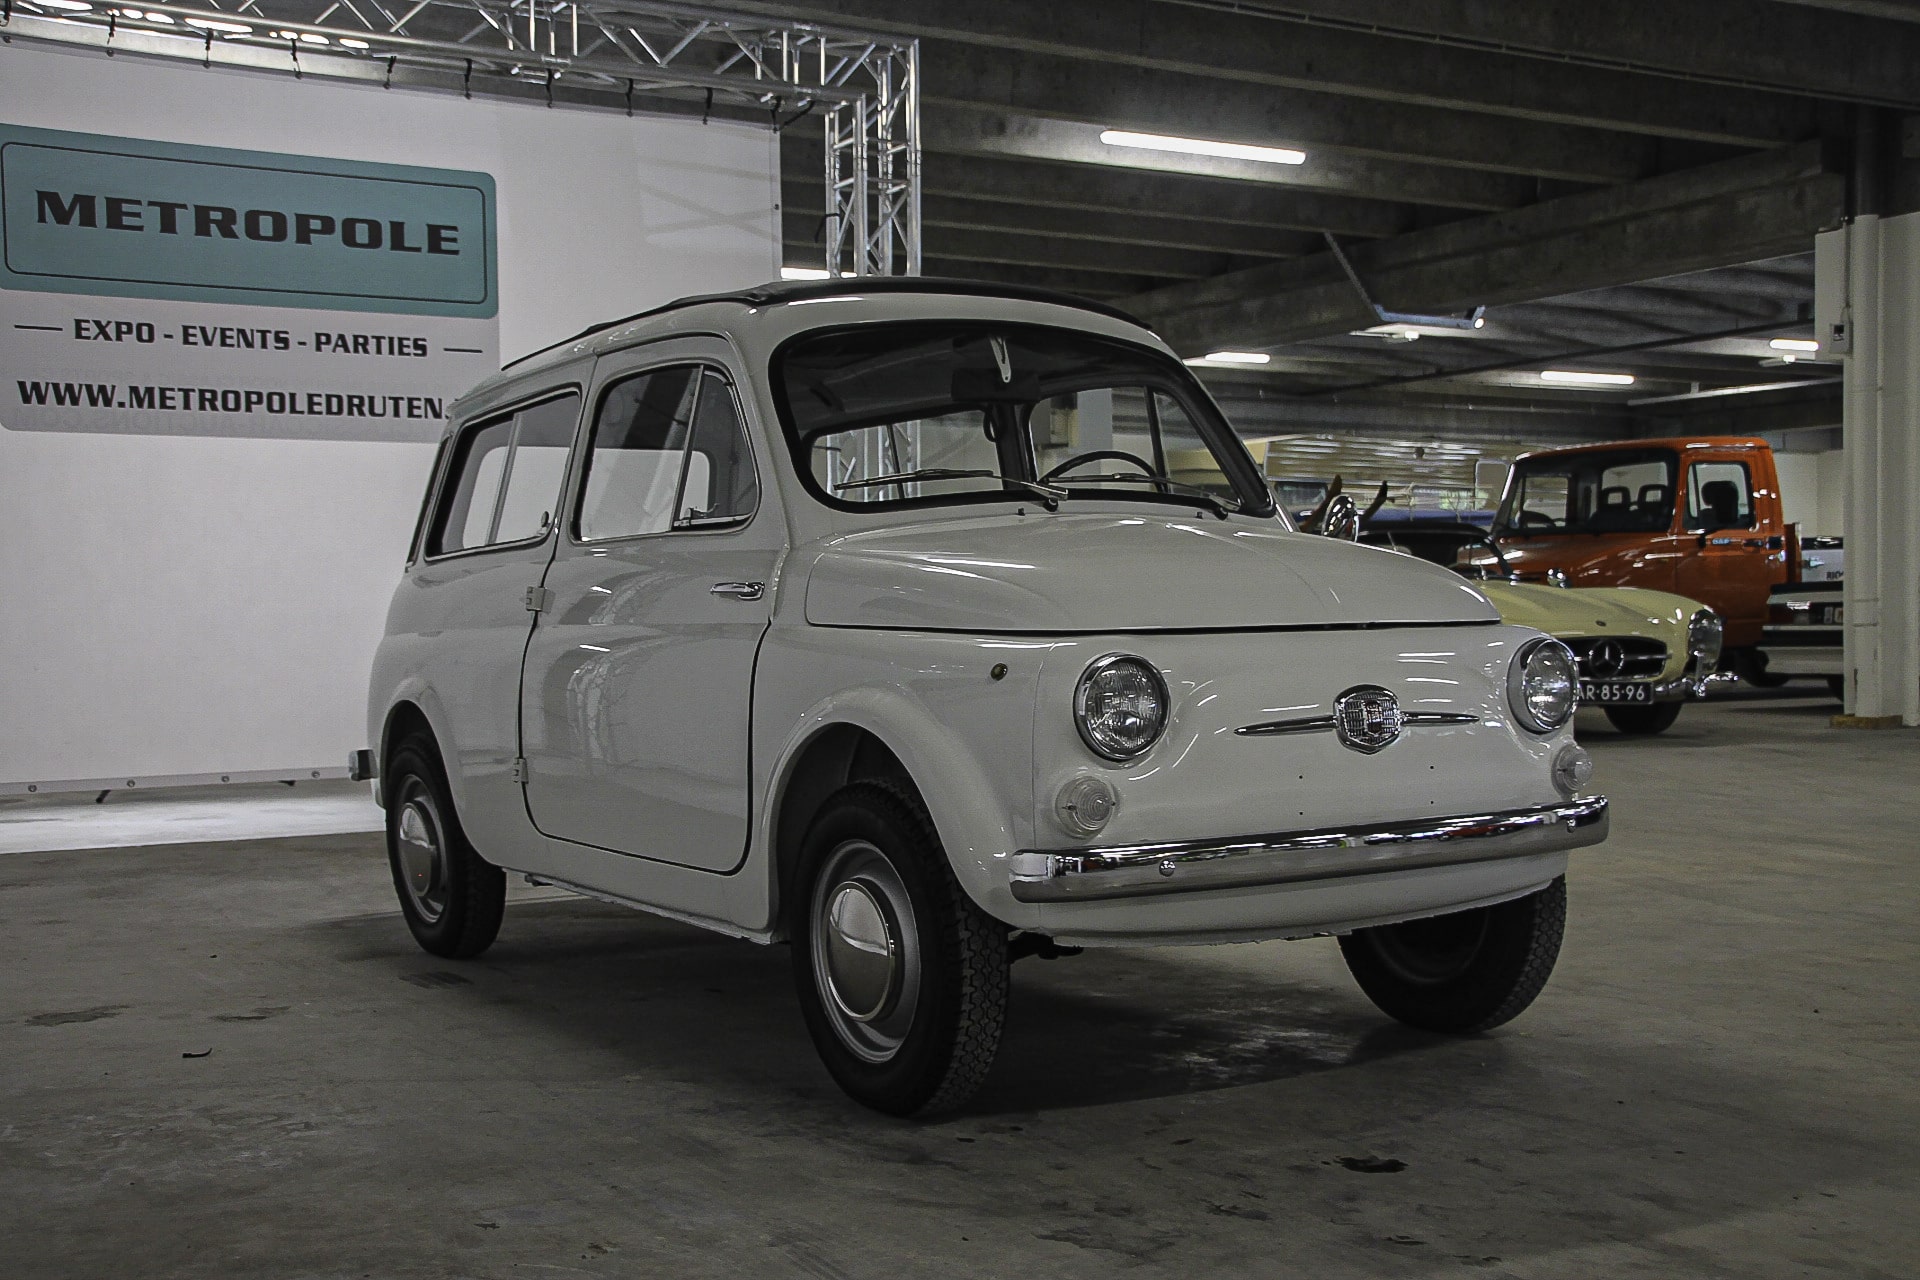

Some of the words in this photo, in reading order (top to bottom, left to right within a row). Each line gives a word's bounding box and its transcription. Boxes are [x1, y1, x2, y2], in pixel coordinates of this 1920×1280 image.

[36, 190, 460, 255] METROPOLE
[74, 318, 155, 344] EXPO
[182, 325, 290, 351] EVENTS
[315, 332, 428, 358] PARTIES
[17, 380, 458, 420] WWW.METROPOLEDRUTEN.
